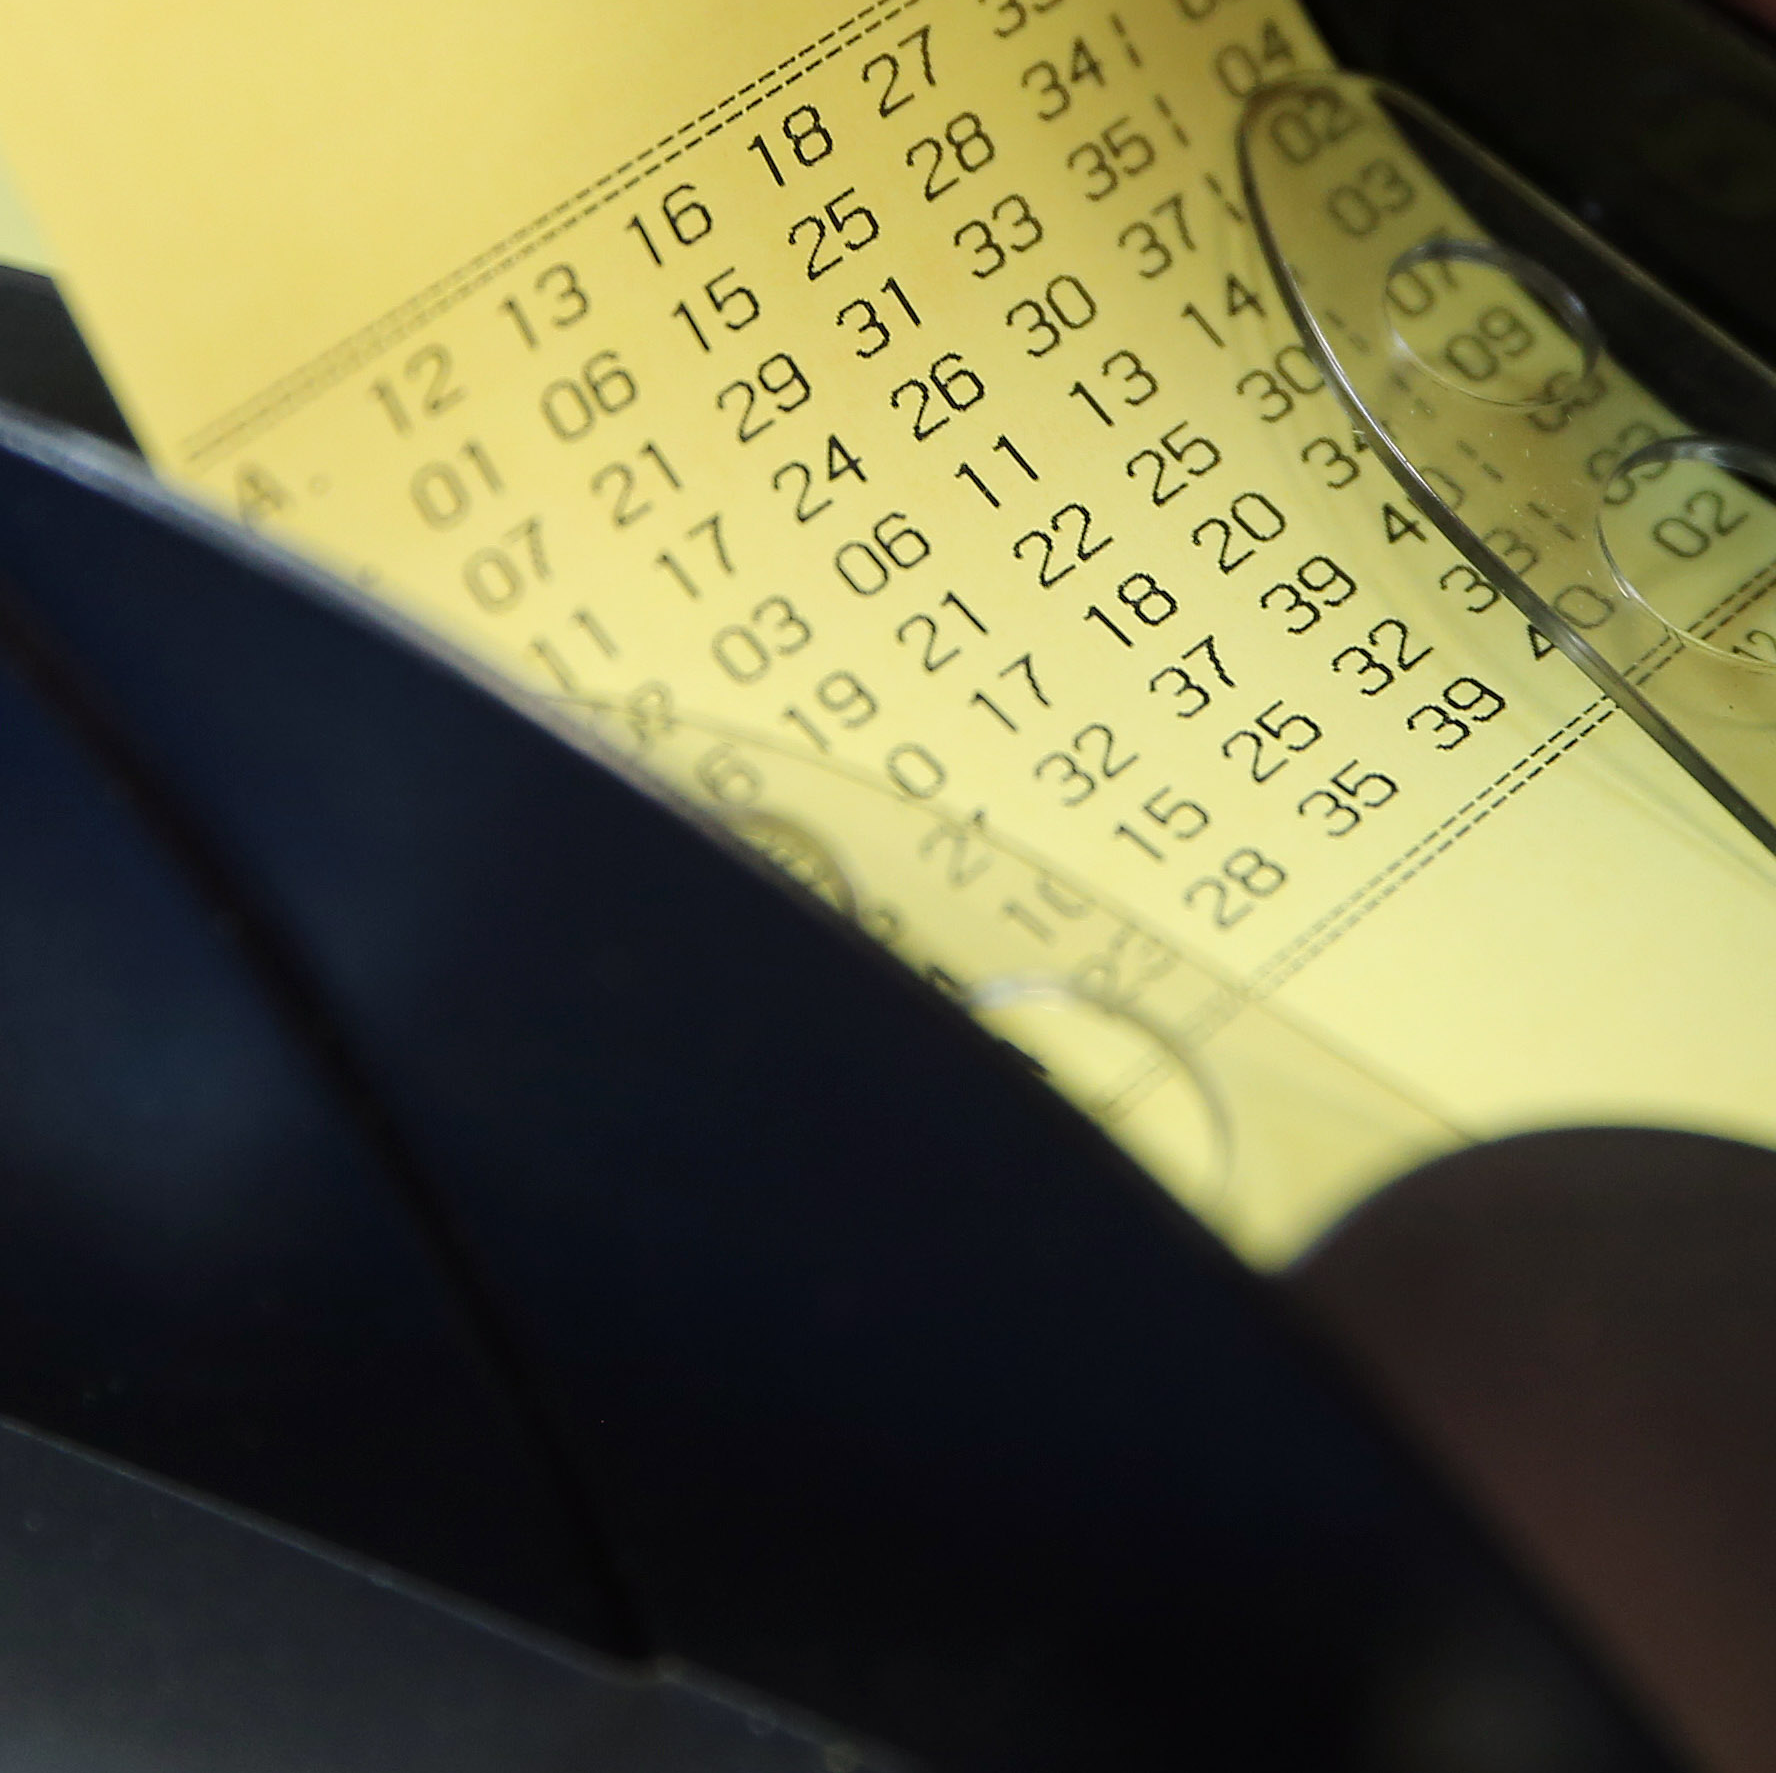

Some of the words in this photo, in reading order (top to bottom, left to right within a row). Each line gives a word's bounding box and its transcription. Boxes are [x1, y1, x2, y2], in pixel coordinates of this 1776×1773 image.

[369, 341, 468, 437] 12
[495, 263, 591, 353] 13
[627, 180, 715, 267] 16
[745, 103, 835, 188] 18
[860, 26, 938, 118] 27
[409, 438, 505, 531] 01
[540, 348, 639, 442] 06
[669, 267, 762, 354] 15
[786, 188, 881, 280] 25
[904, 109, 997, 201] 28
[1020, 35, 1106, 122] 34
[460, 517, 553, 614] 07
[590, 438, 684, 529] 21
[715, 351, 812, 444] 29
[835, 276, 922, 359] 31
[952, 193, 1045, 280] 33
[1067, 116, 1156, 204] 35
[1215, 16, 1295, 100] 04
[529, 607, 620, 695] 11
[655, 514, 736, 601] 17
[772, 434, 867, 524] 24
[891, 352, 985, 442] 26
[1005, 274, 1098, 358] 30
[1116, 192, 1198, 280] 37
[711, 595, 813, 685] 03
[834, 511, 931, 597] 06
[955, 434, 1039, 509] 11
[1068, 350, 1159, 428] 13
[1182, 272, 1265, 349] 14
[1325, 158, 1417, 238] 03
[782, 669, 879, 755] 19
[896, 591, 988, 672] 21
[1012, 503, 1113, 588] 22
[1127, 420, 1221, 506] 25
[1236, 343, 1325, 423] 30
[970, 653, 1052, 734] 17
[1084, 572, 1179, 648] 18
[1191, 493, 1287, 575] 20
[1443, 304, 1537, 383] 09
[1034, 722, 1141, 807] 32
[1150, 636, 1236, 720] 37
[1260, 555, 1357, 635] 39
[1183, 846, 1289, 933] 28
[1297, 760, 1399, 838] 35
[1406, 676, 1507, 752] 39
[1652, 489, 1750, 559] 02
[1113, 785, 1211, 862] 15
[1221, 700, 1323, 784] 25
[1331, 618, 1434, 697] 32
